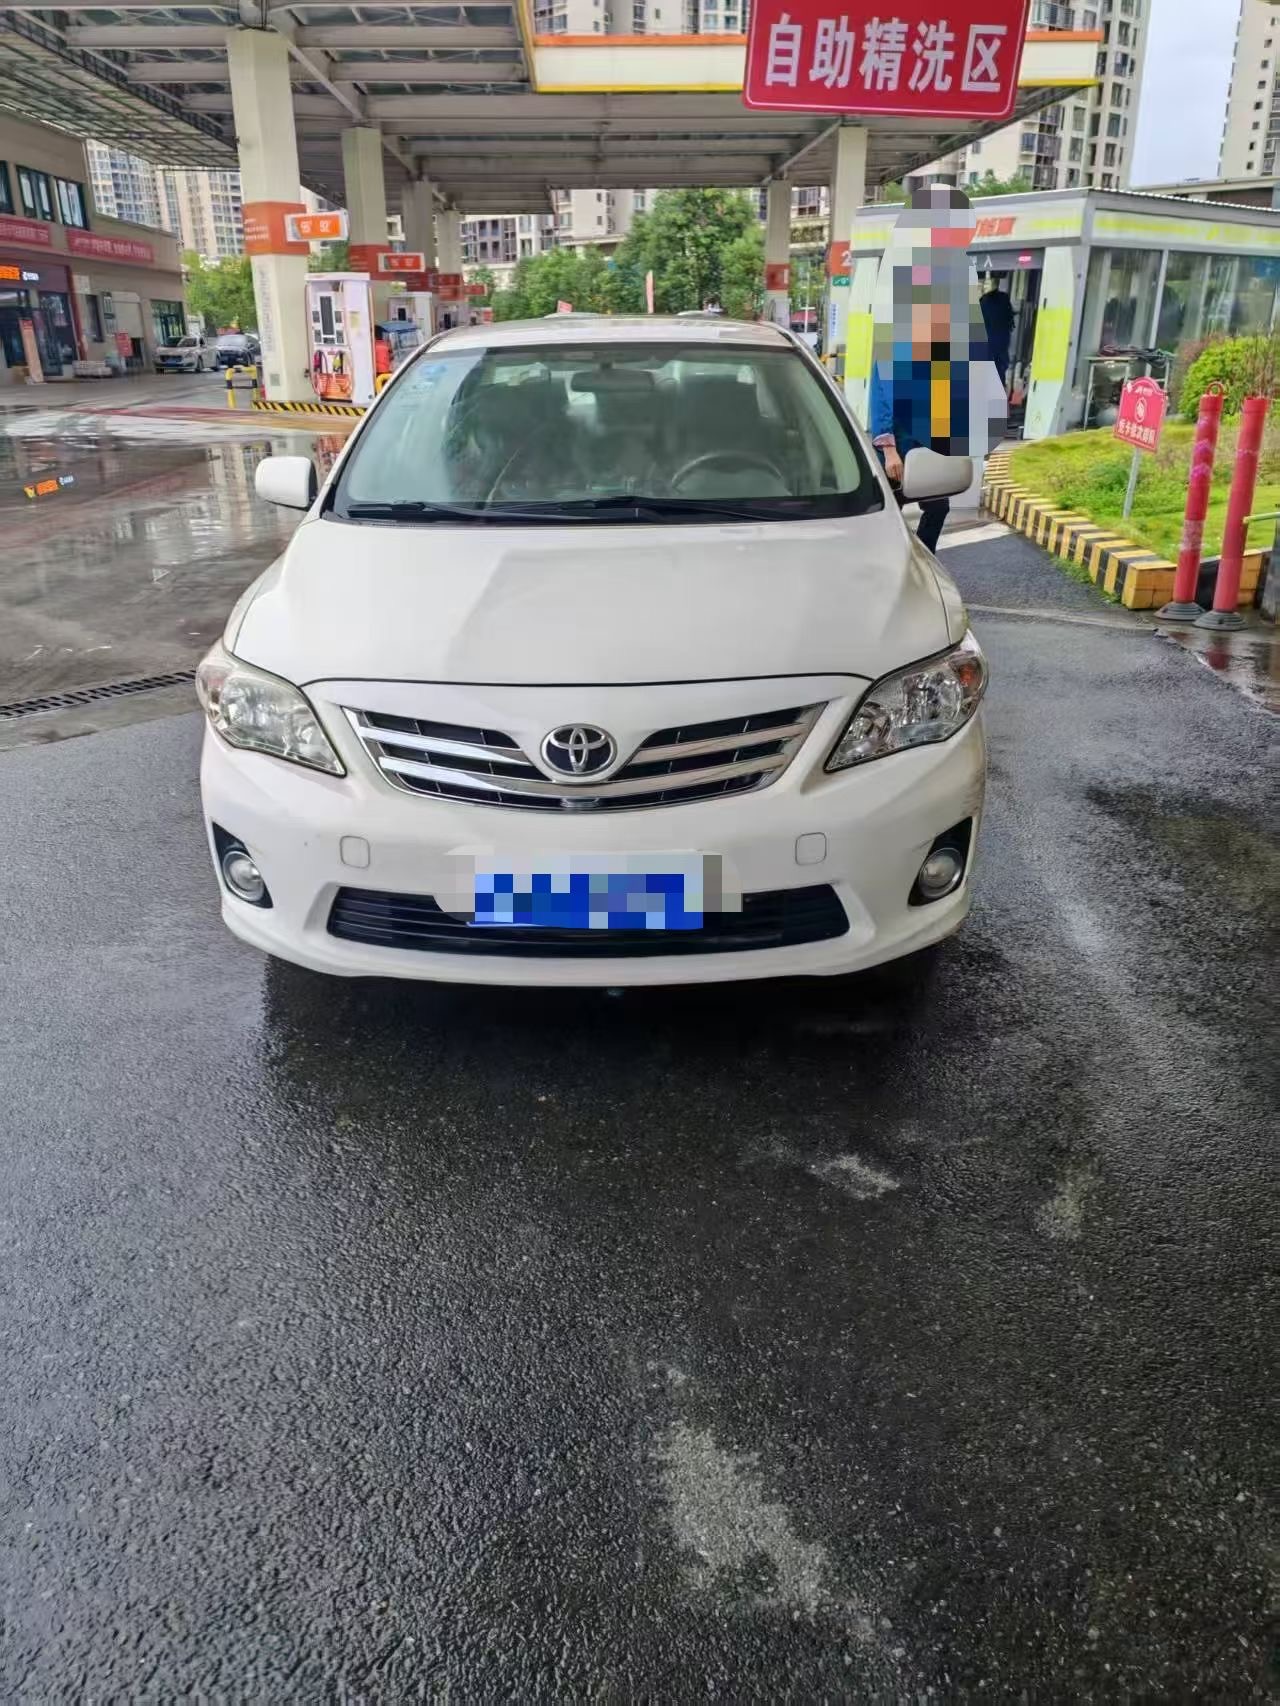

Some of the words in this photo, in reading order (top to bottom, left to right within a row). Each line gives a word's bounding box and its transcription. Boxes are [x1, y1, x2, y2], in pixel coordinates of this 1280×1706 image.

[765, 13, 1008, 92] 自助精洗区
[840, 250, 853, 267] 2
